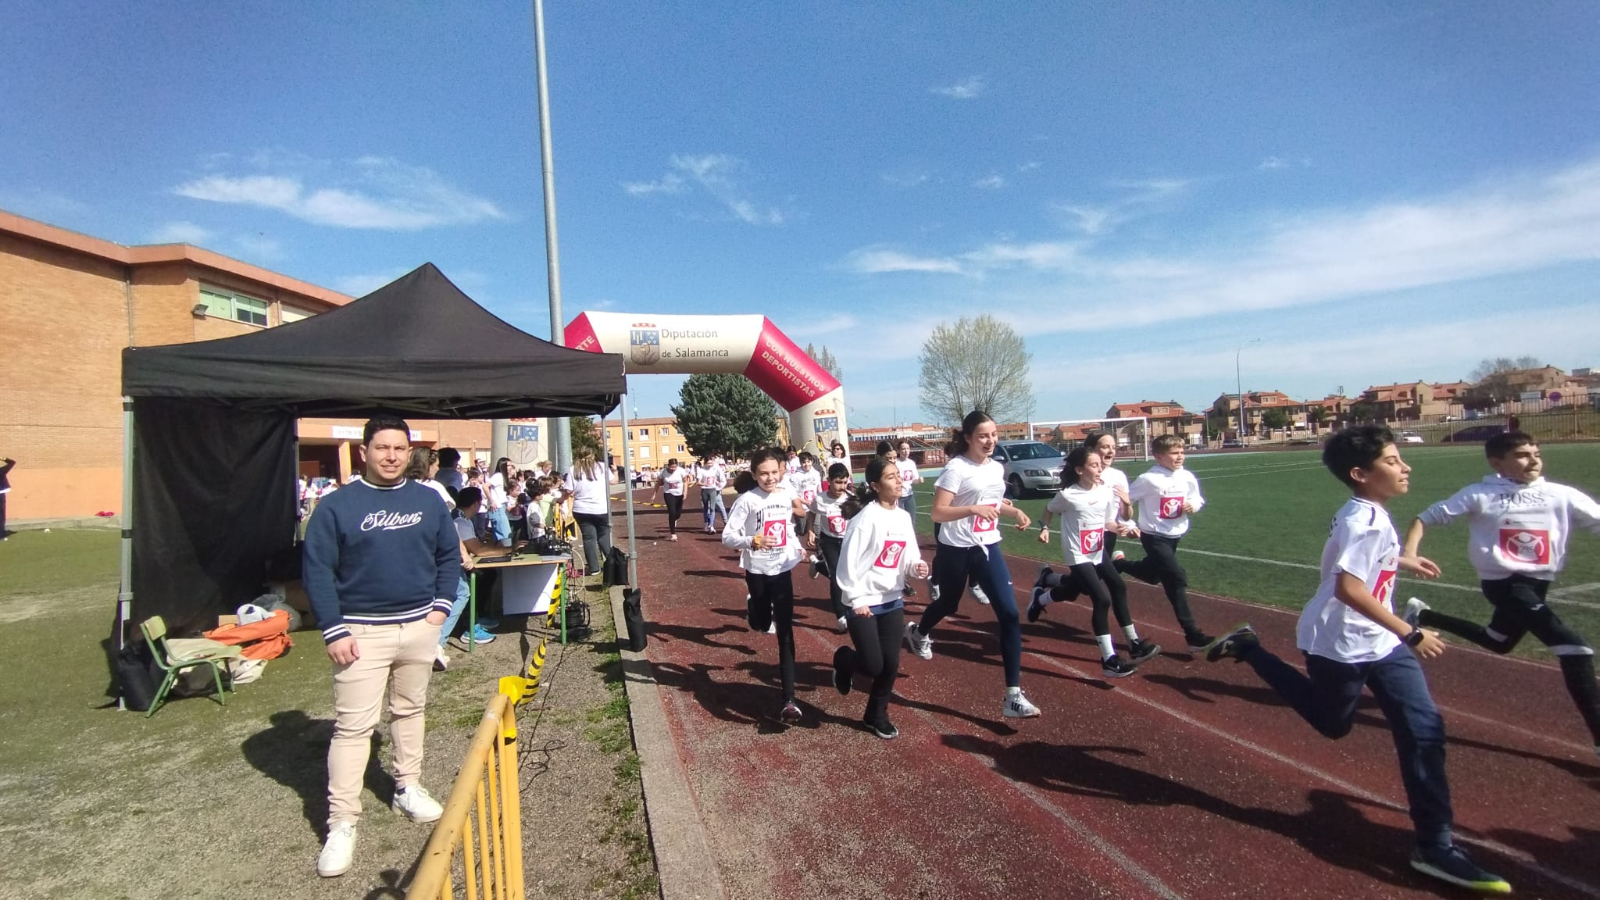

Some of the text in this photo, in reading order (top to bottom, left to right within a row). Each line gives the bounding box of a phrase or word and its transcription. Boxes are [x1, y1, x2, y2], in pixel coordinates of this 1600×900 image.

[662, 347, 729, 358] de Salamanca
[765, 339, 826, 391] CON NUESTROS
[761, 351, 816, 397] DEPORTISTAS
[1499, 491, 1545, 506] BOSS
